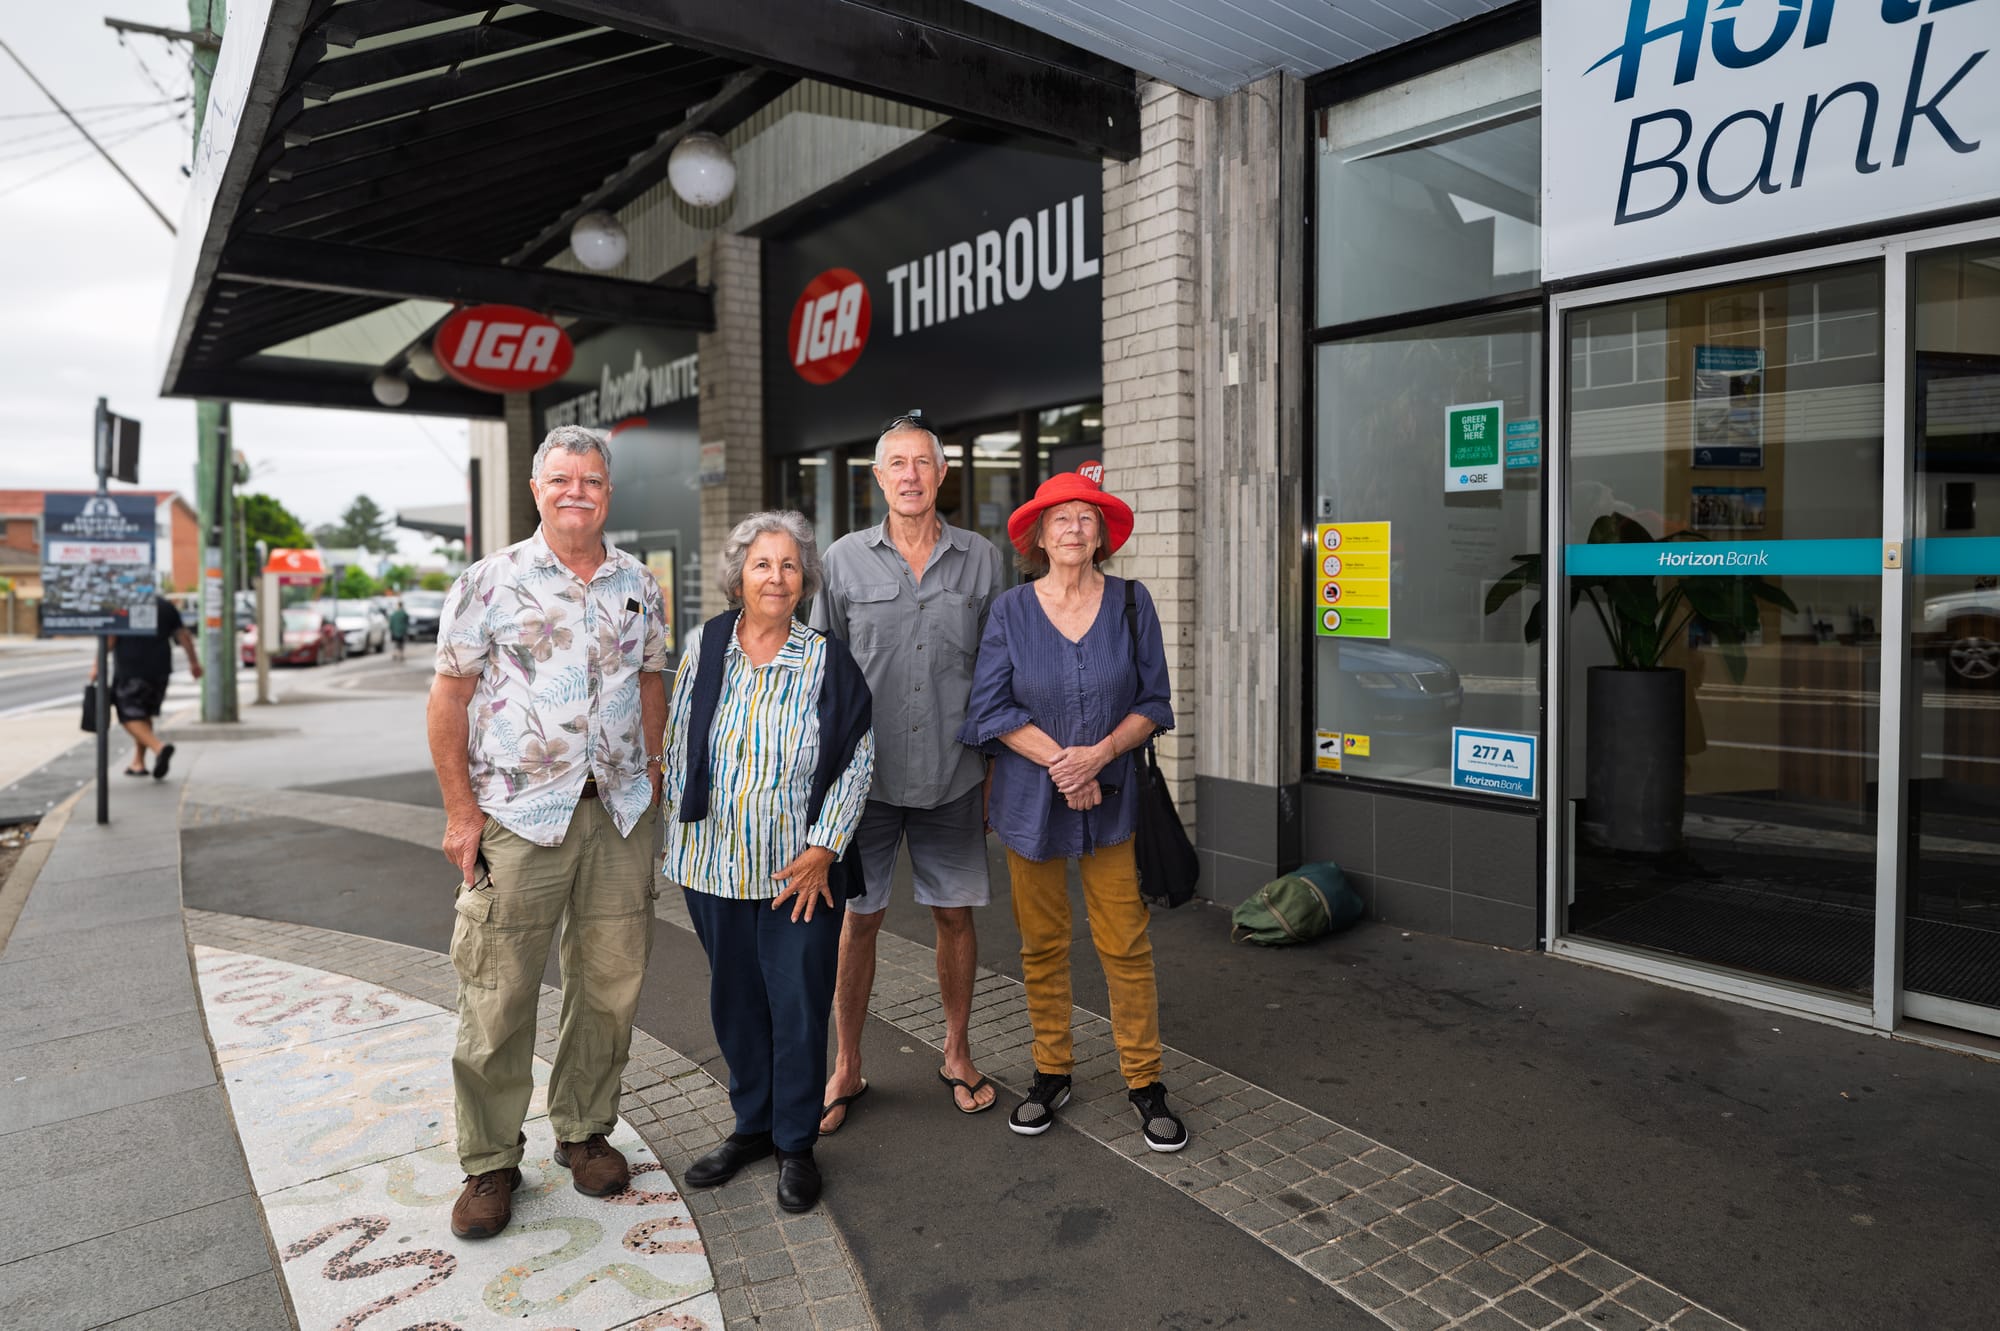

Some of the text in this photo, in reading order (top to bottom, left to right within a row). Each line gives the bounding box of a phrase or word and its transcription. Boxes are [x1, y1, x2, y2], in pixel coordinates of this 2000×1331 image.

[1614, 22, 1990, 226] Bank
[887, 194, 1100, 337] THIRROUL
[795, 282, 863, 366] IGA
[453, 320, 561, 372] IGA
[1461, 415, 1486, 424] GREEN
[1463, 422, 1485, 432] SLIPS
[1464, 432, 1484, 440] HERE
[1470, 473, 1488, 484] QBE
[1472, 744, 1515, 762] 277 A
